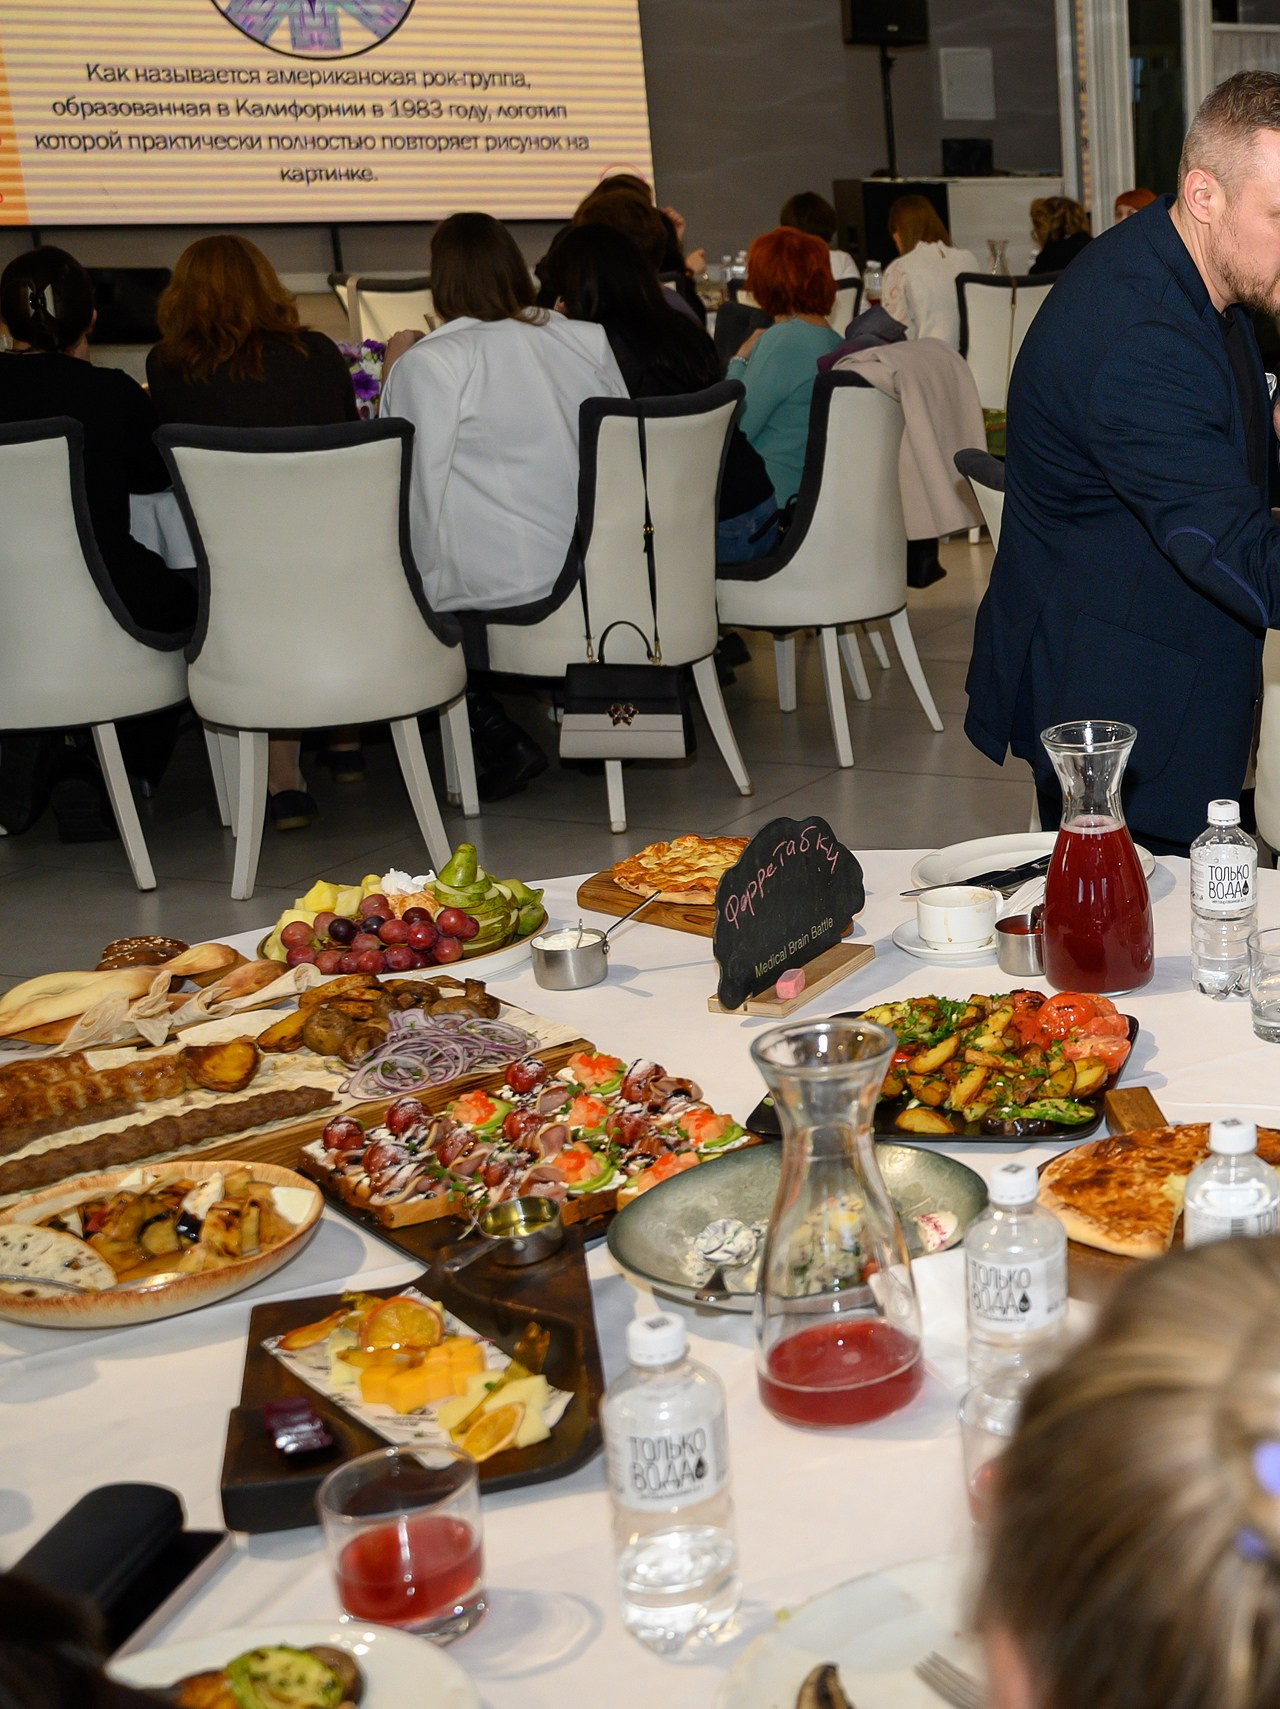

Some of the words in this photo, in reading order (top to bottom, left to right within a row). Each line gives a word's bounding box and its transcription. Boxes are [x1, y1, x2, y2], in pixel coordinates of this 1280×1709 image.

[86, 63, 131, 83] Как
[135, 67, 261, 85] называется
[266, 69, 417, 88] американская
[422, 71, 532, 91] рок-группа,
[52, 95, 211, 119] образованная
[217, 103, 230, 117] в
[235, 98, 366, 121] Калифорнии
[372, 103, 384, 117] в
[390, 98, 443, 119] 1983
[449, 103, 492, 123] году,
[497, 104, 568, 120] логотип
[35, 130, 122, 152] которой
[128, 134, 262, 152] практически
[268, 134, 376, 151] полностью
[381, 135, 480, 153] повторяет
[485, 135, 562, 153] рисунок
[567, 136, 590, 150] на
[280, 167, 379, 186] картинке.
[1208, 864, 1250, 882] ТОЛЬКО
[1208, 880, 1243, 900] ВОДА
[755, 946, 788, 978] Medical
[788, 933, 810, 955] Brain
[810, 917, 834, 940] Battle
[970, 1260, 1031, 1290] ТОЛЬКО
[972, 1282, 1020, 1315] ВОДА
[629, 1427, 707, 1462] ТОЛЬКО
[632, 1459, 696, 1492] ВОДА
